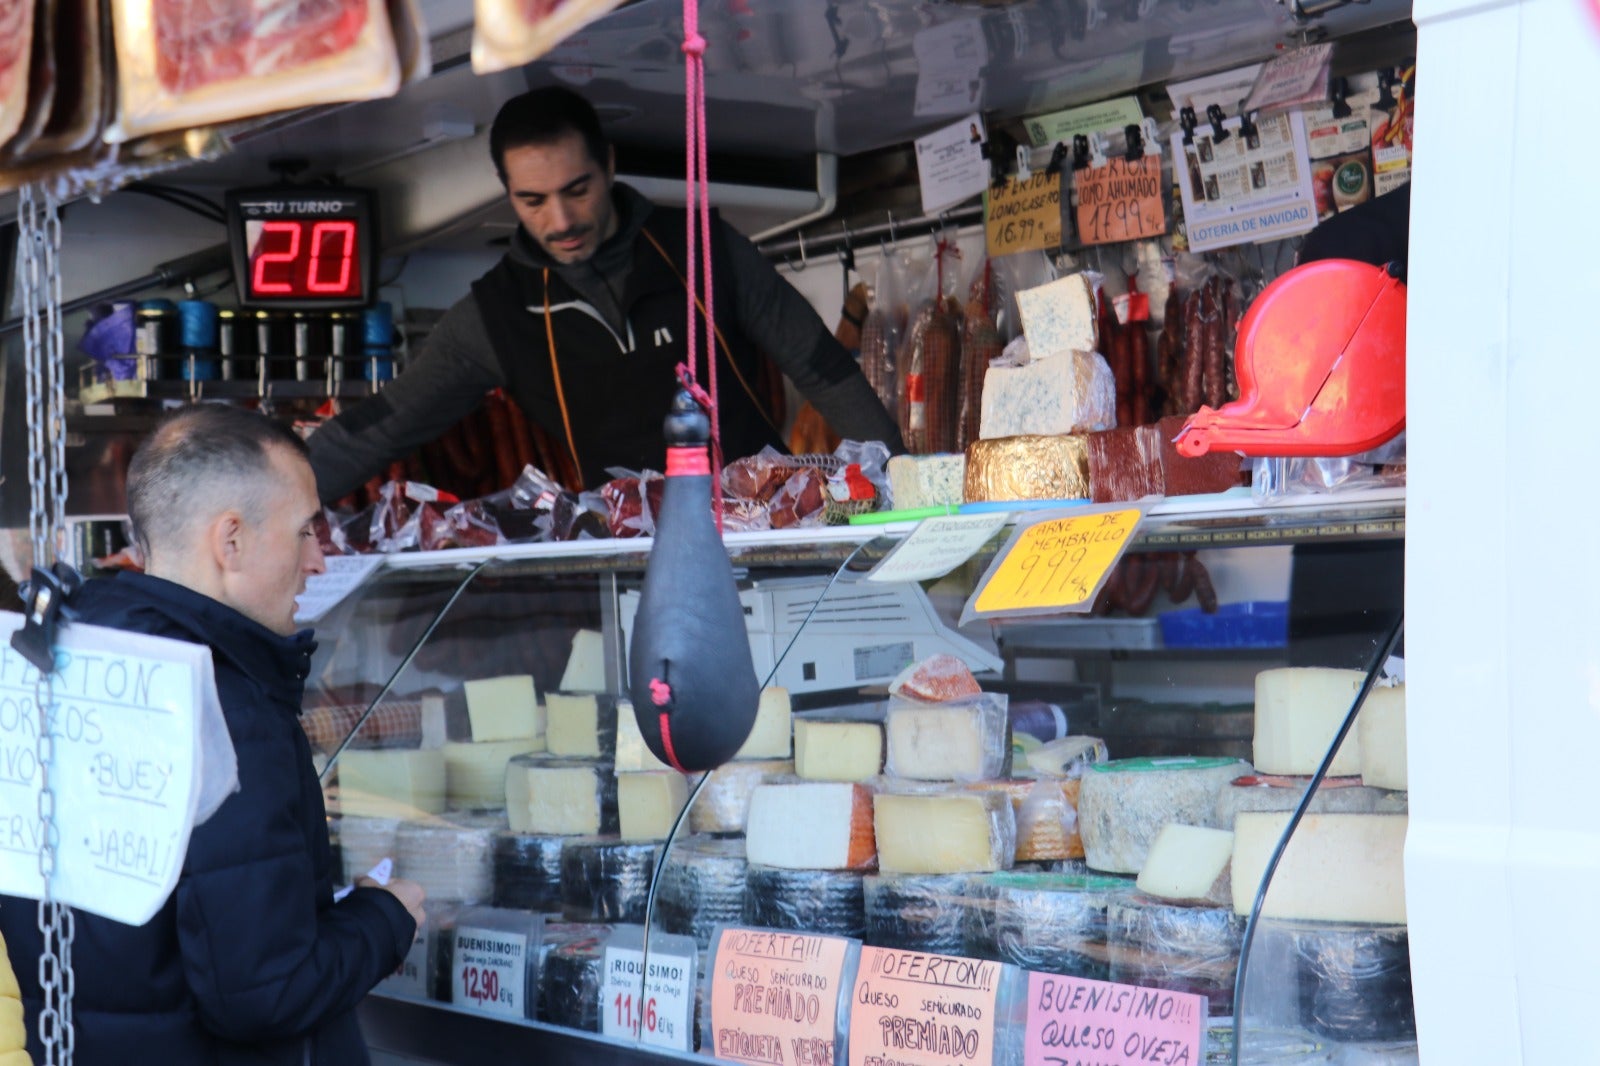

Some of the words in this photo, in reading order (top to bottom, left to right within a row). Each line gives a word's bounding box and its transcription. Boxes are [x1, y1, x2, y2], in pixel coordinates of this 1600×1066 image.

[264, 201, 284, 213] SU
[289, 201, 342, 213] TURNO
[1078, 183, 1104, 206] LOMO
[1106, 177, 1157, 201] AHUMADO
[1193, 222, 1240, 242] LOTERIA
[1242, 218, 1257, 232] DE
[1259, 206, 1309, 228] NAVIDAD
[253, 221, 355, 293] 20
[1026, 518, 1074, 538] CARNE
[1099, 512, 1124, 528] DE
[1032, 527, 1126, 551] MEMBRILLO
[94, 751, 173, 800] BUEY
[457, 935, 521, 957] BUENISIMO!!!
[462, 966, 499, 1007] 12,90
[733, 983, 820, 1025] PREMIADO
[718, 1027, 784, 1063] ETIQUETA
[878, 1015, 979, 1060] PREMIADO
[1123, 1032, 1190, 1066] OVEJA
